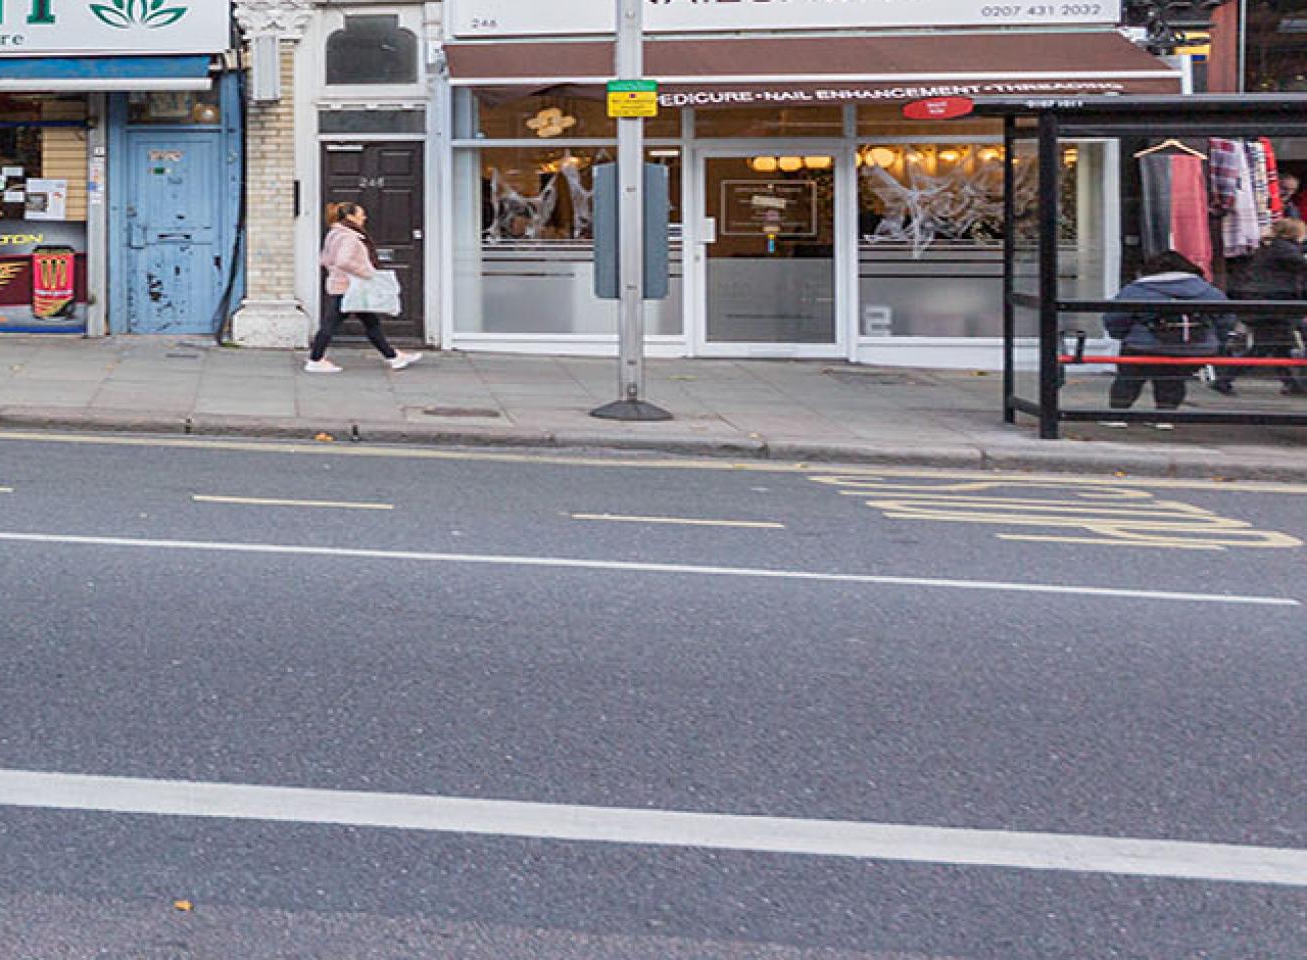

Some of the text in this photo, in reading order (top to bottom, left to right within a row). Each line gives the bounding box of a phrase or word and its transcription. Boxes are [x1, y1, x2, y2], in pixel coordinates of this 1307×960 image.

[981, 3, 1102, 17] 0207 431 2032
[658, 92, 754, 106] EDICURE
[764, 91, 813, 101] NAIL
